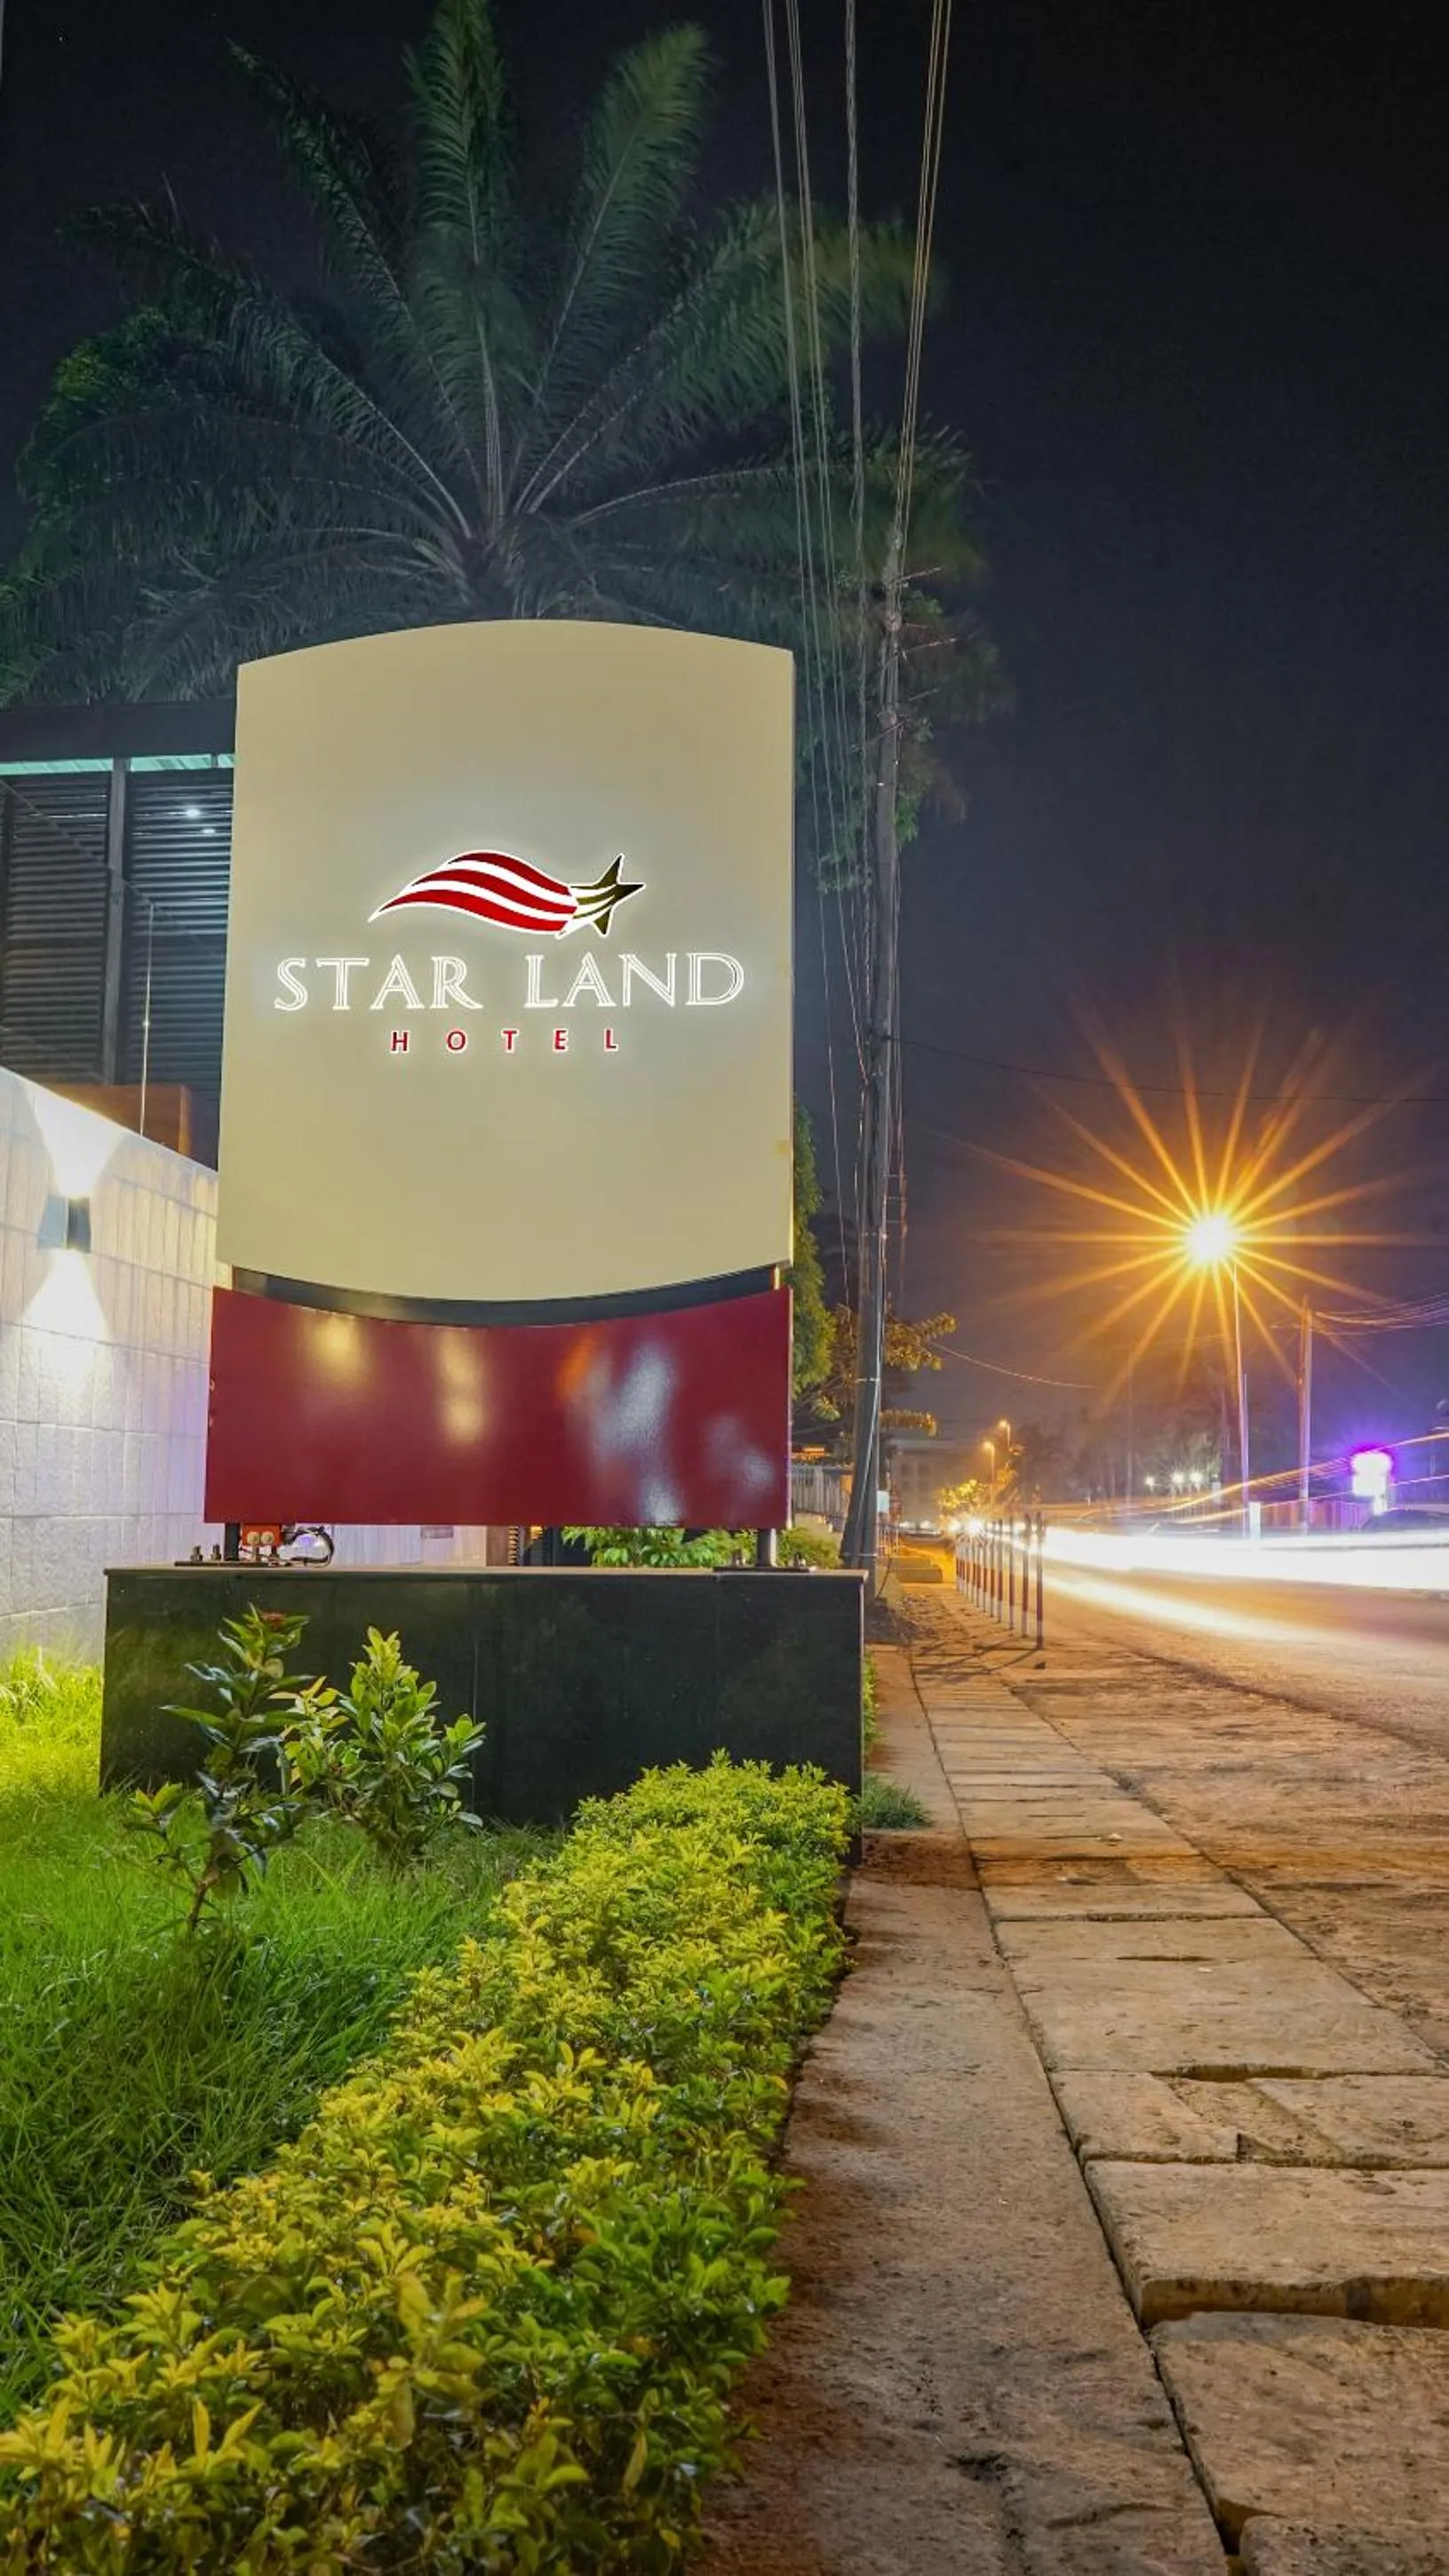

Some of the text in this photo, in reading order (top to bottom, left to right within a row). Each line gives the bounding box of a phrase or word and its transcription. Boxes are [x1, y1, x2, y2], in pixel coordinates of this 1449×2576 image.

[275, 952, 744, 1011] STAR LAND
[390, 1027, 619, 1053] HOTEL
